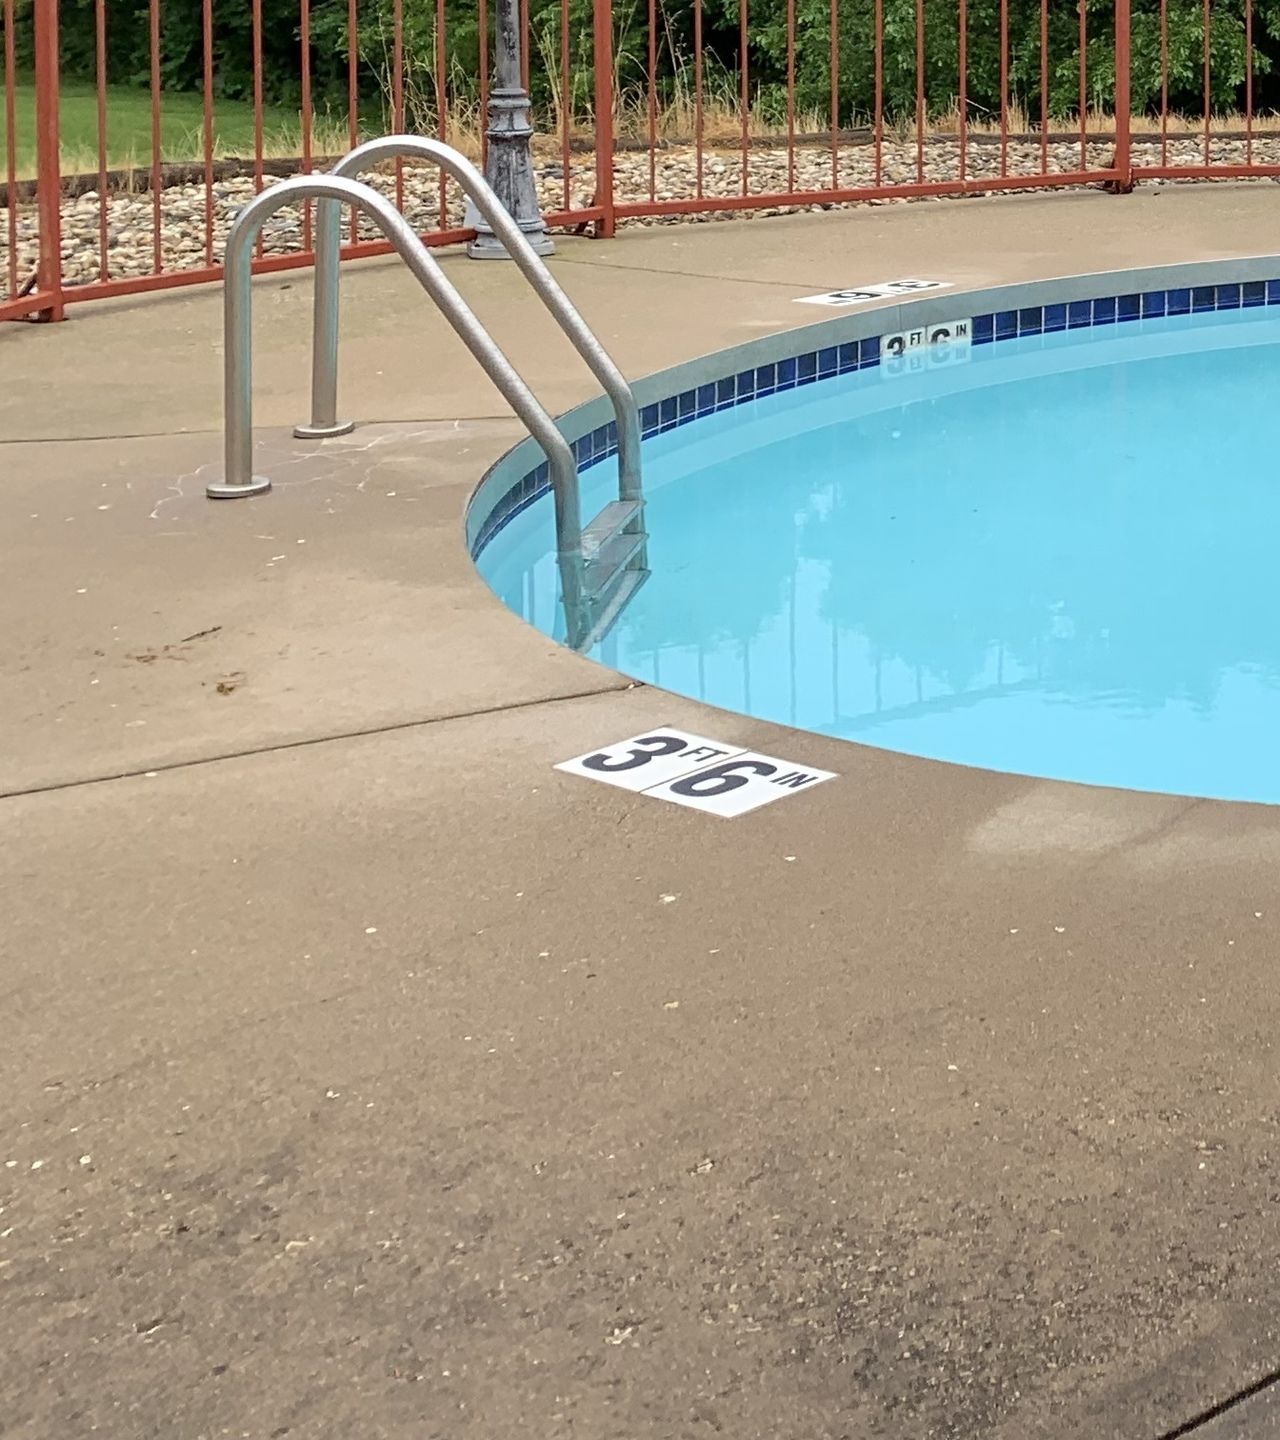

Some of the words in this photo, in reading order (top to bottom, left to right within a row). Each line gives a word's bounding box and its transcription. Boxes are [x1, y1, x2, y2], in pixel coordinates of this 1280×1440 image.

[910, 332, 923, 346] FT
[956, 323, 967, 337] IN
[582, 735, 689, 772] 3
[677, 745, 731, 763] FT
[669, 760, 778, 797] 6
[769, 771, 818, 789] IN
